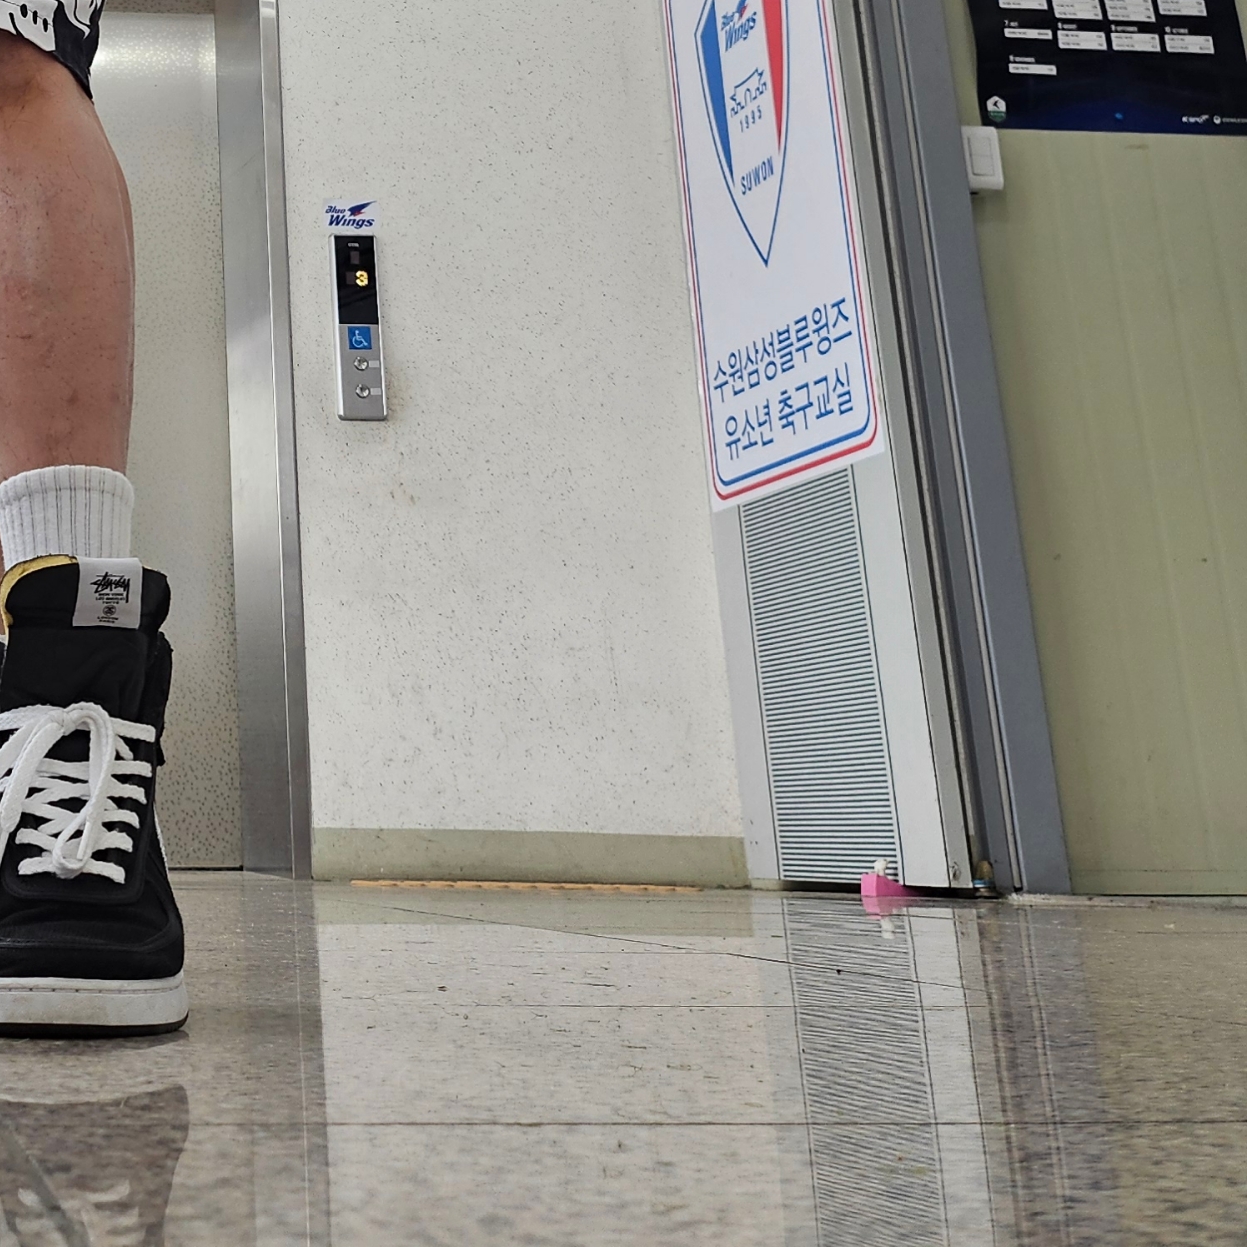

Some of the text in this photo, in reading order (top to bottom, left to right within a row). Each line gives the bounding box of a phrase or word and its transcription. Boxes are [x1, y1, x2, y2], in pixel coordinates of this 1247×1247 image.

[724, 11, 758, 52] Wings
[739, 105, 763, 133] 1995
[740, 156, 774, 196] SUWON
[327, 214, 375, 230] Wings
[355, 270, 369, 287] 3
[712, 297, 853, 403] 수원삼성블루윙즈
[725, 362, 854, 461] 유소년 축구교실
